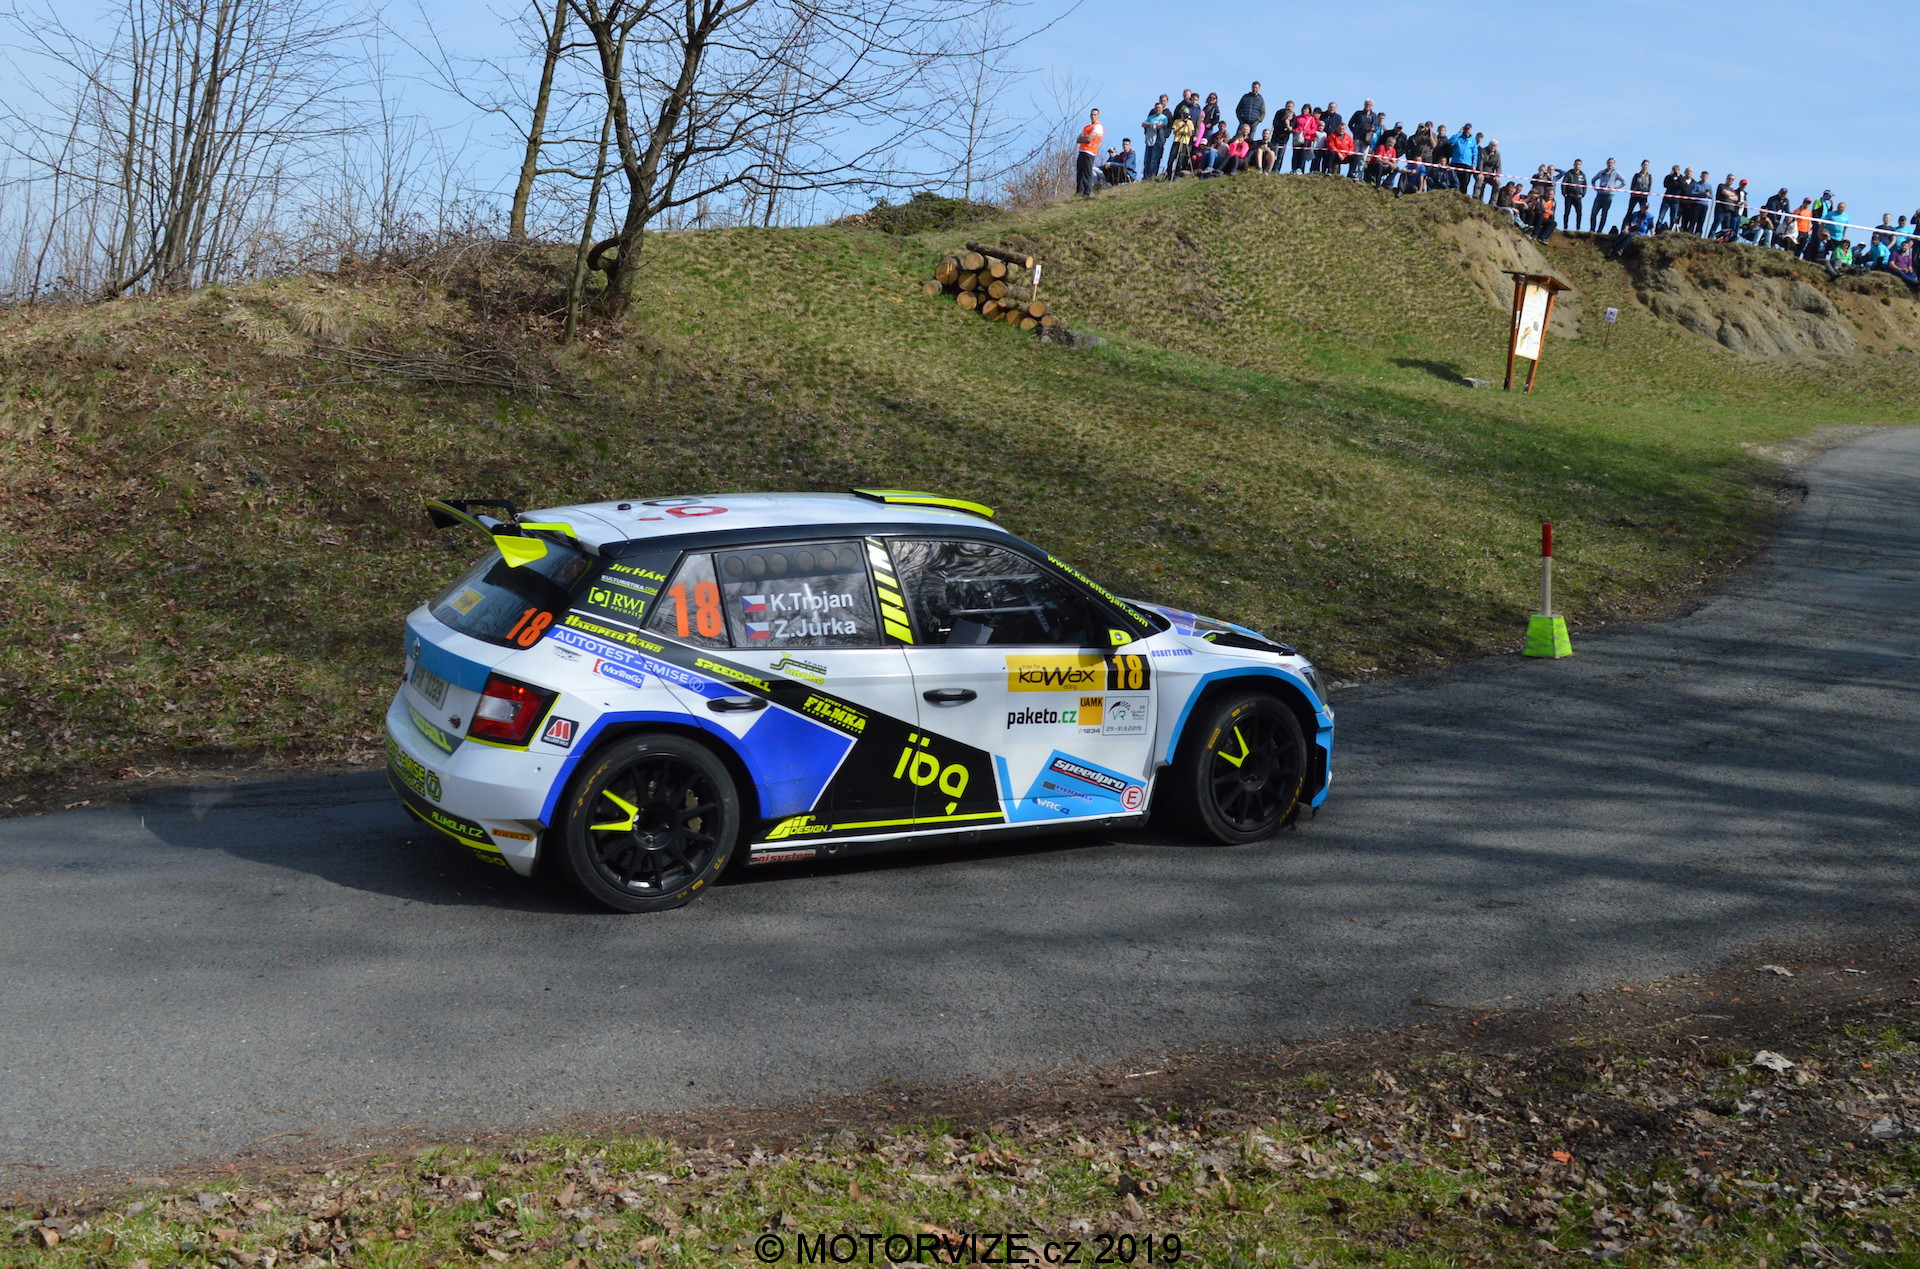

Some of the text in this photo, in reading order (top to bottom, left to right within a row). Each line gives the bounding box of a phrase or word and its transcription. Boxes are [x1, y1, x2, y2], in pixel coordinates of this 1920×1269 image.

[610, 605, 643, 620] security
[612, 592, 646, 614] RWI
[668, 581, 722, 638] 18
[770, 590, 854, 614] K.Trojan
[505, 607, 553, 648] 18
[554, 629, 634, 664] AUTOTEST
[642, 660, 690, 684] EMISE
[1111, 654, 1143, 690] 18
[803, 696, 866, 731] FILMKA
[1007, 706, 1077, 730] paketo.cz
[1053, 759, 1126, 790] speedpro
[1126, 790, 1138, 805] E
[789, 824, 828, 835] DESIGN
